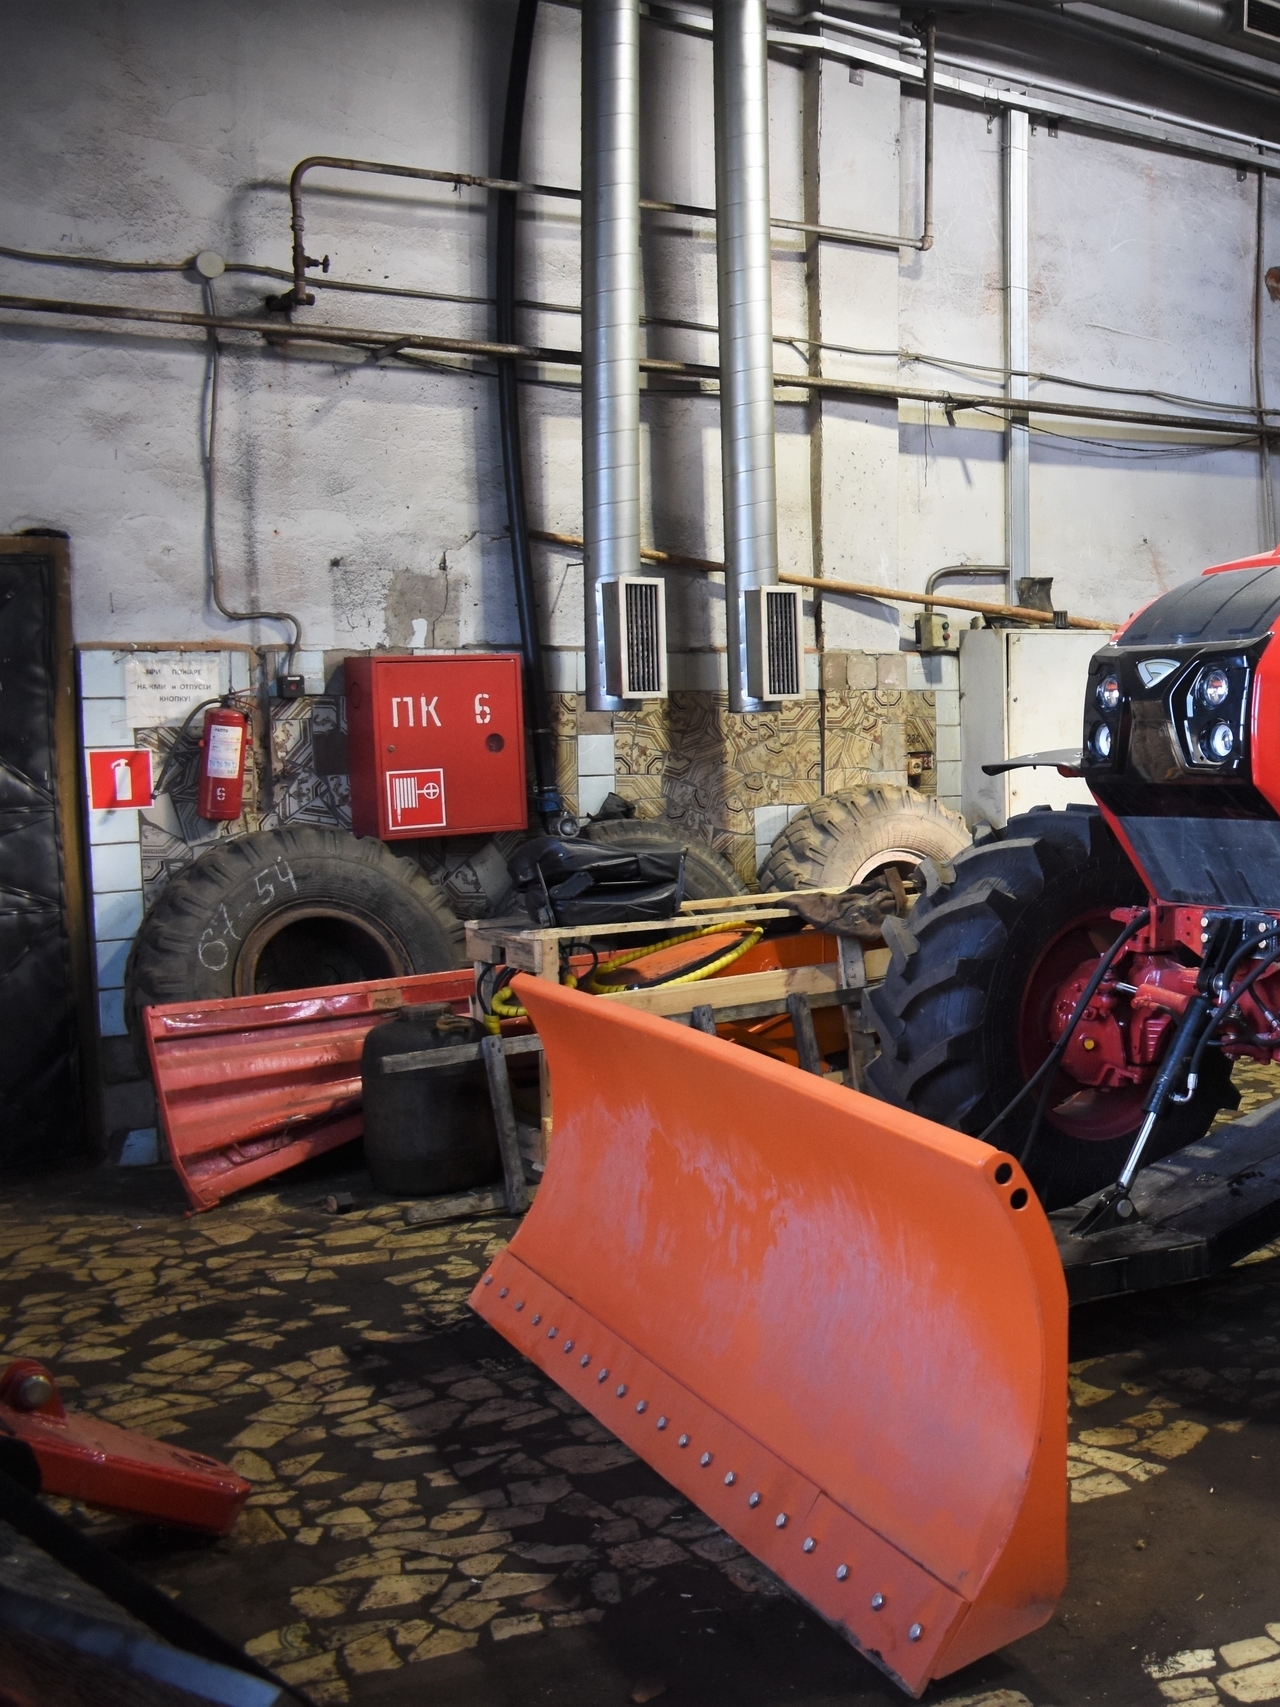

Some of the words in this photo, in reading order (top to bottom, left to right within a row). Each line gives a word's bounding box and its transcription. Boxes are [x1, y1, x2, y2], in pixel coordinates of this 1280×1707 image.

[171, 668, 202, 676] ПОЖАРЕ
[392, 695, 442, 728] ПК
[474, 693, 491, 724] 6
